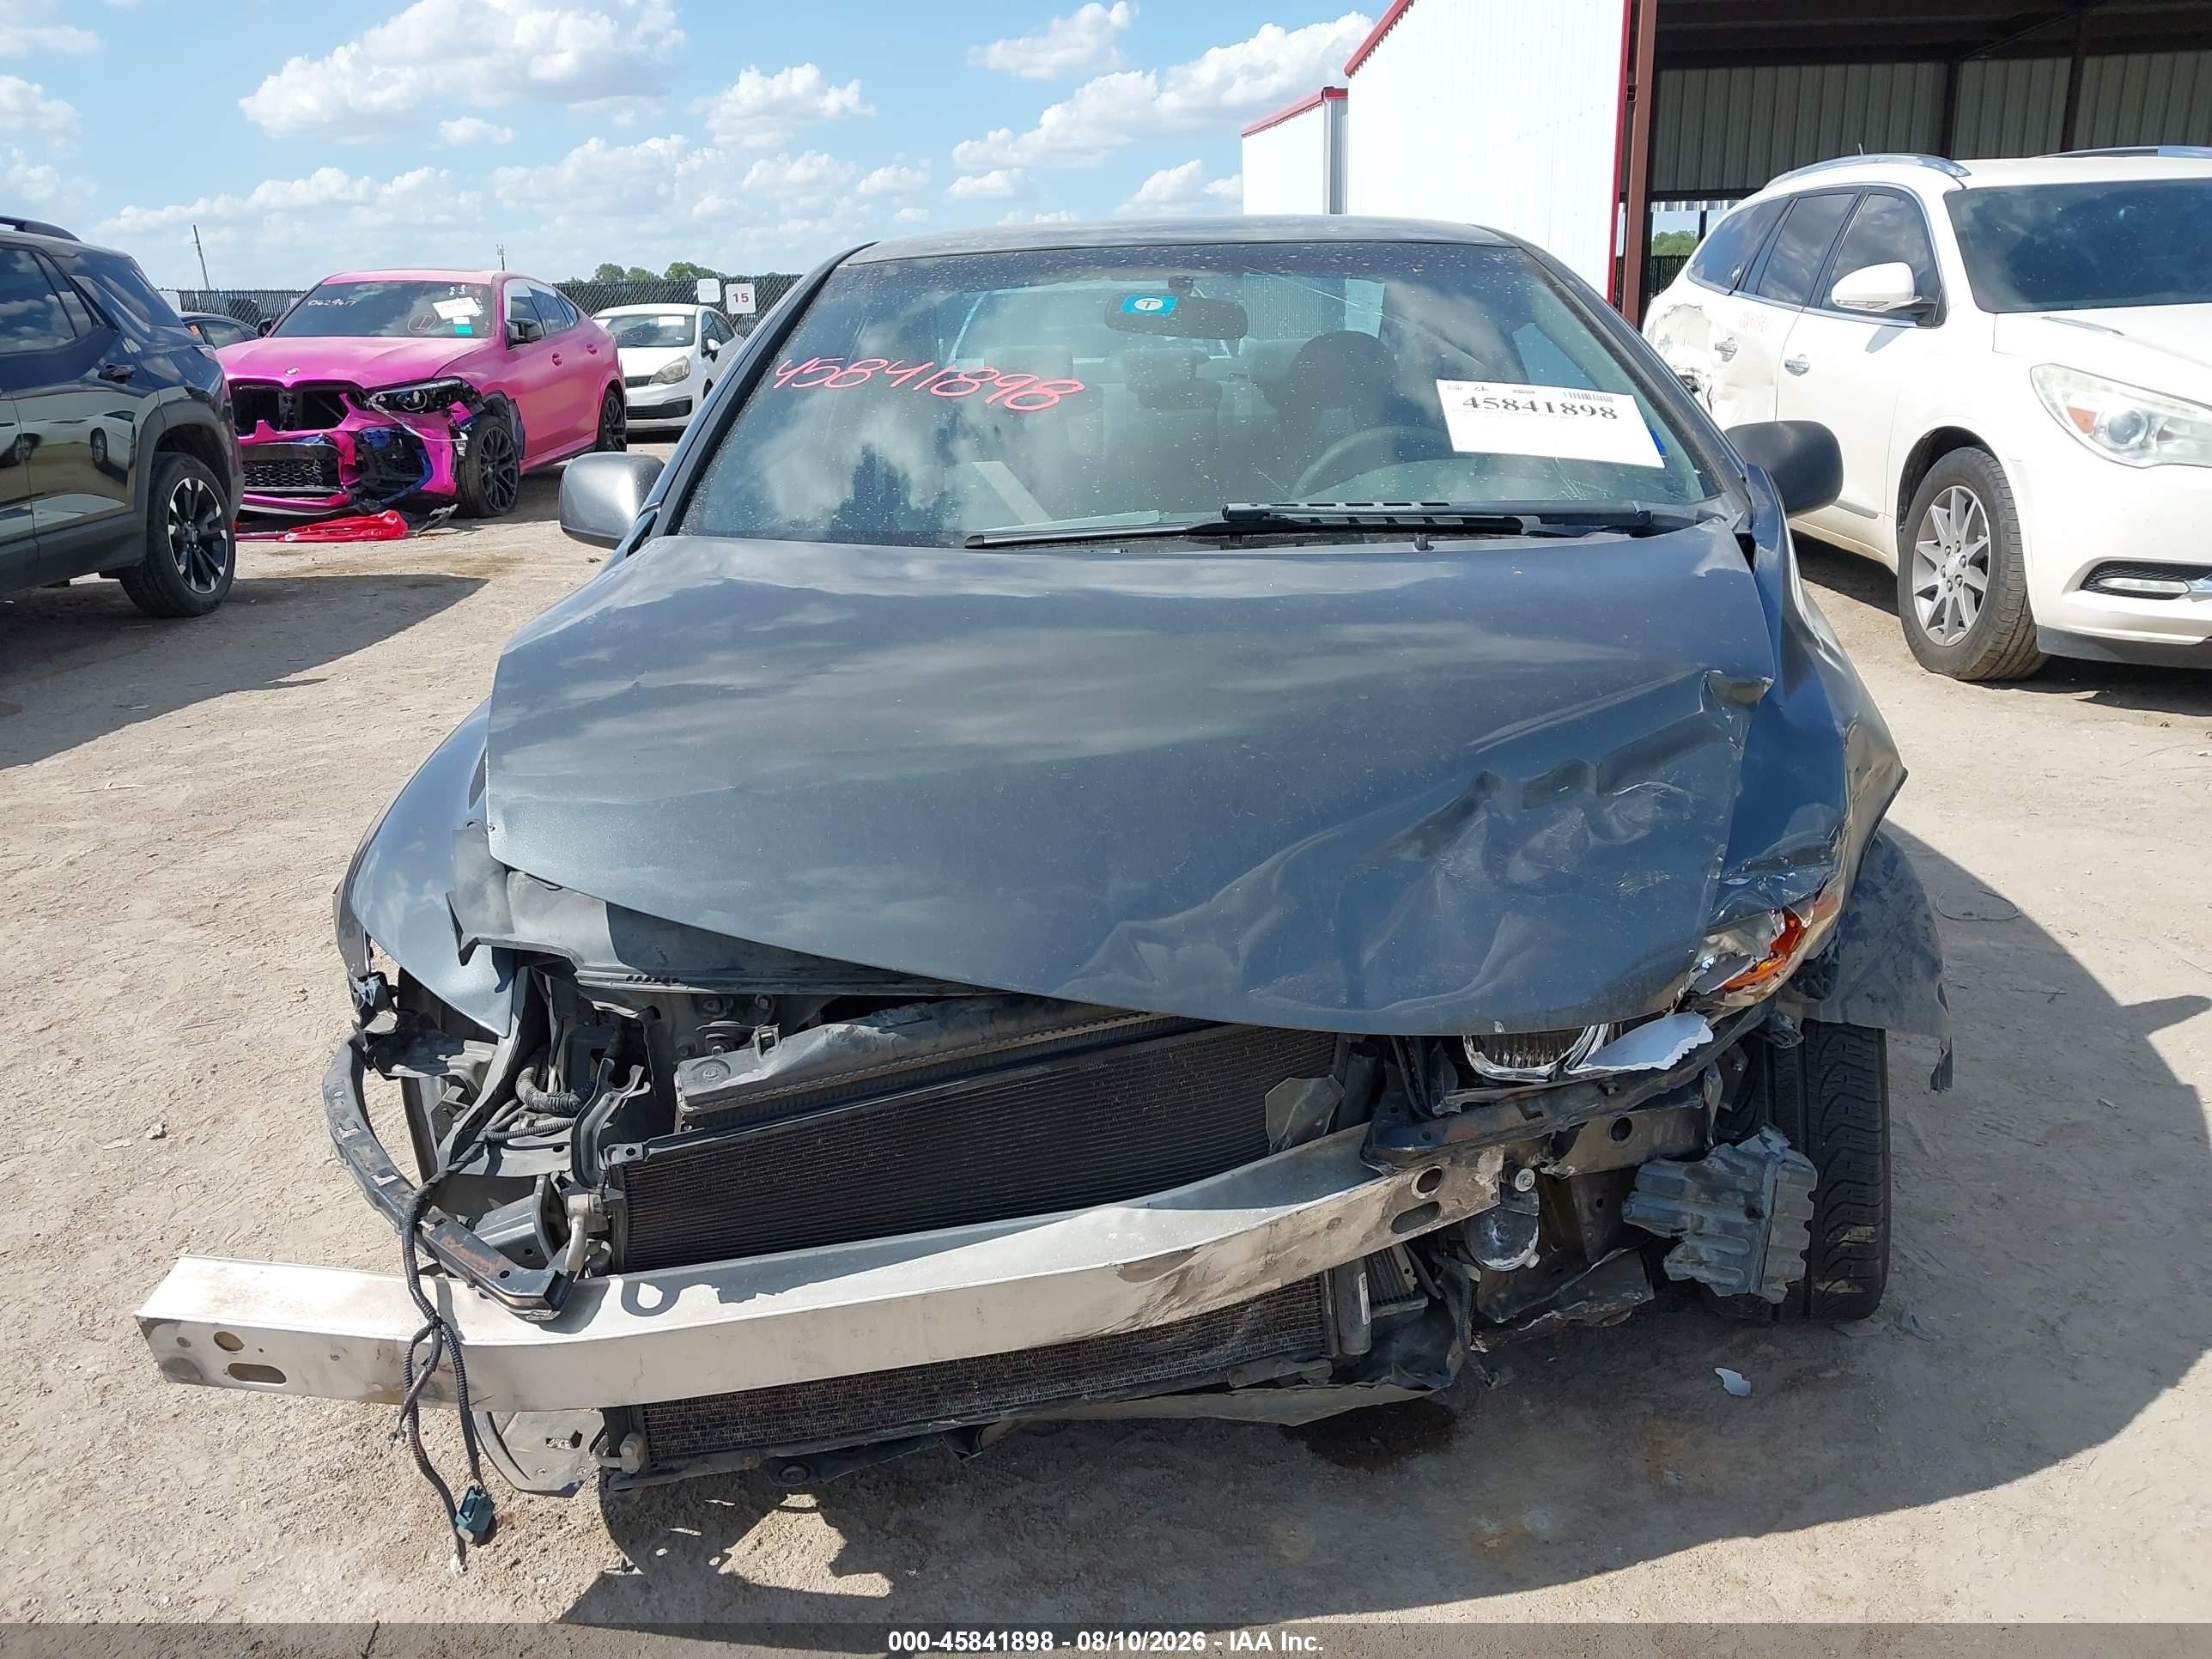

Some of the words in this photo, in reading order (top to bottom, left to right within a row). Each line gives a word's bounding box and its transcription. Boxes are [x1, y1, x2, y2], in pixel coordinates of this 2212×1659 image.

[732, 292, 750, 303] 15
[773, 356, 1085, 412] 45841898
[1462, 396, 1619, 420] 45841898
